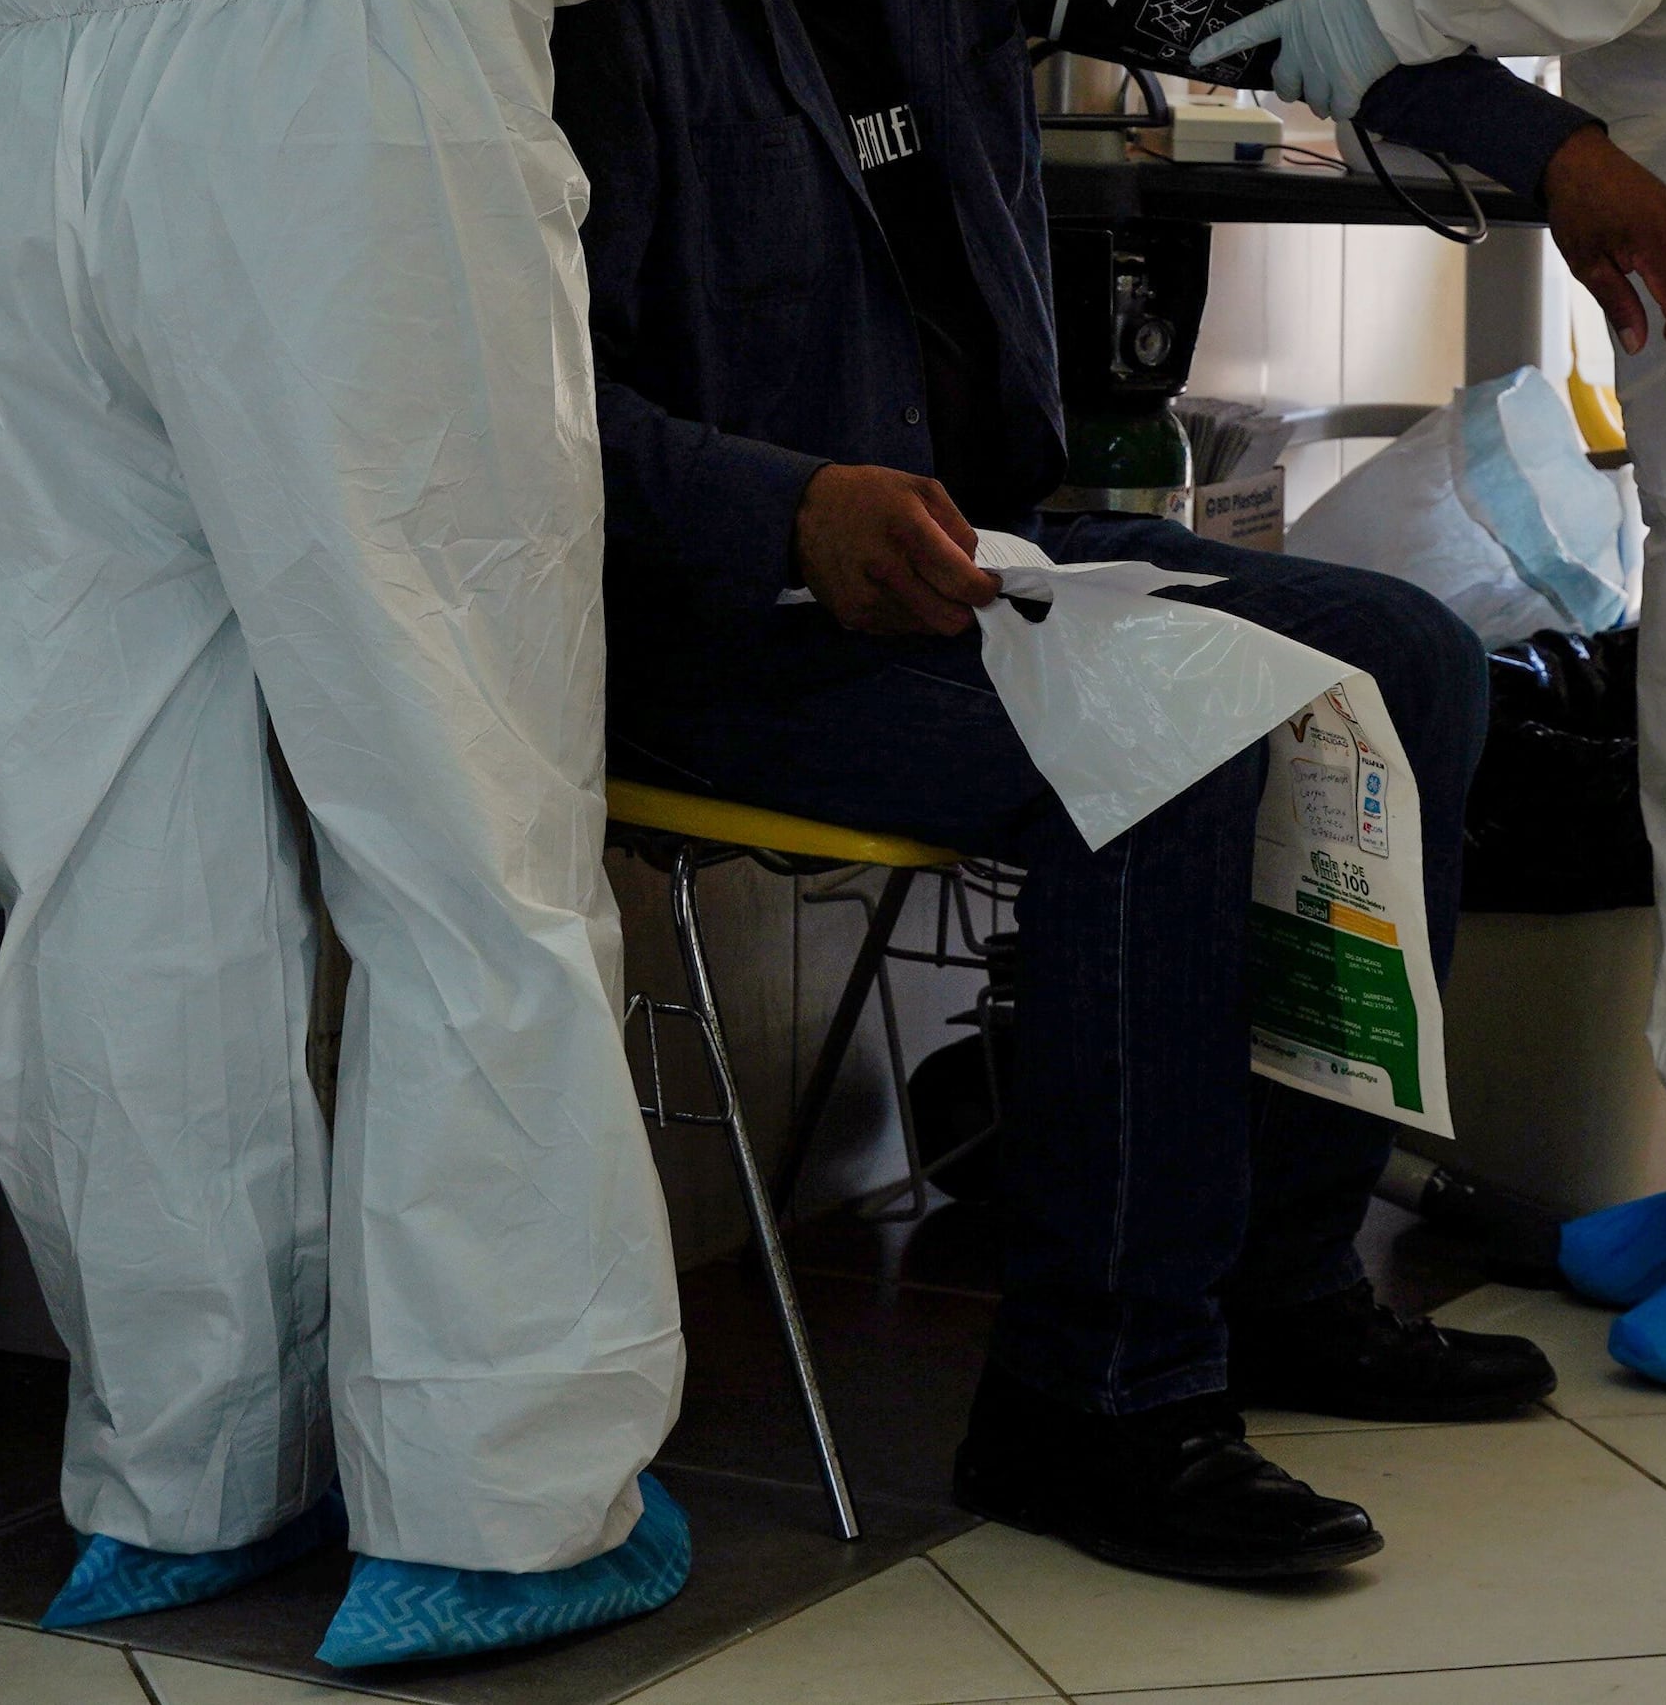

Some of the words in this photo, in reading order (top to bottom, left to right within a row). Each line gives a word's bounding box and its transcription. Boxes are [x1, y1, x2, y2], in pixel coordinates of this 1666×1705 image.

[1351, 864, 1365, 878] DE
[1342, 872, 1369, 896] 100
[1298, 900, 1328, 920] Digital
